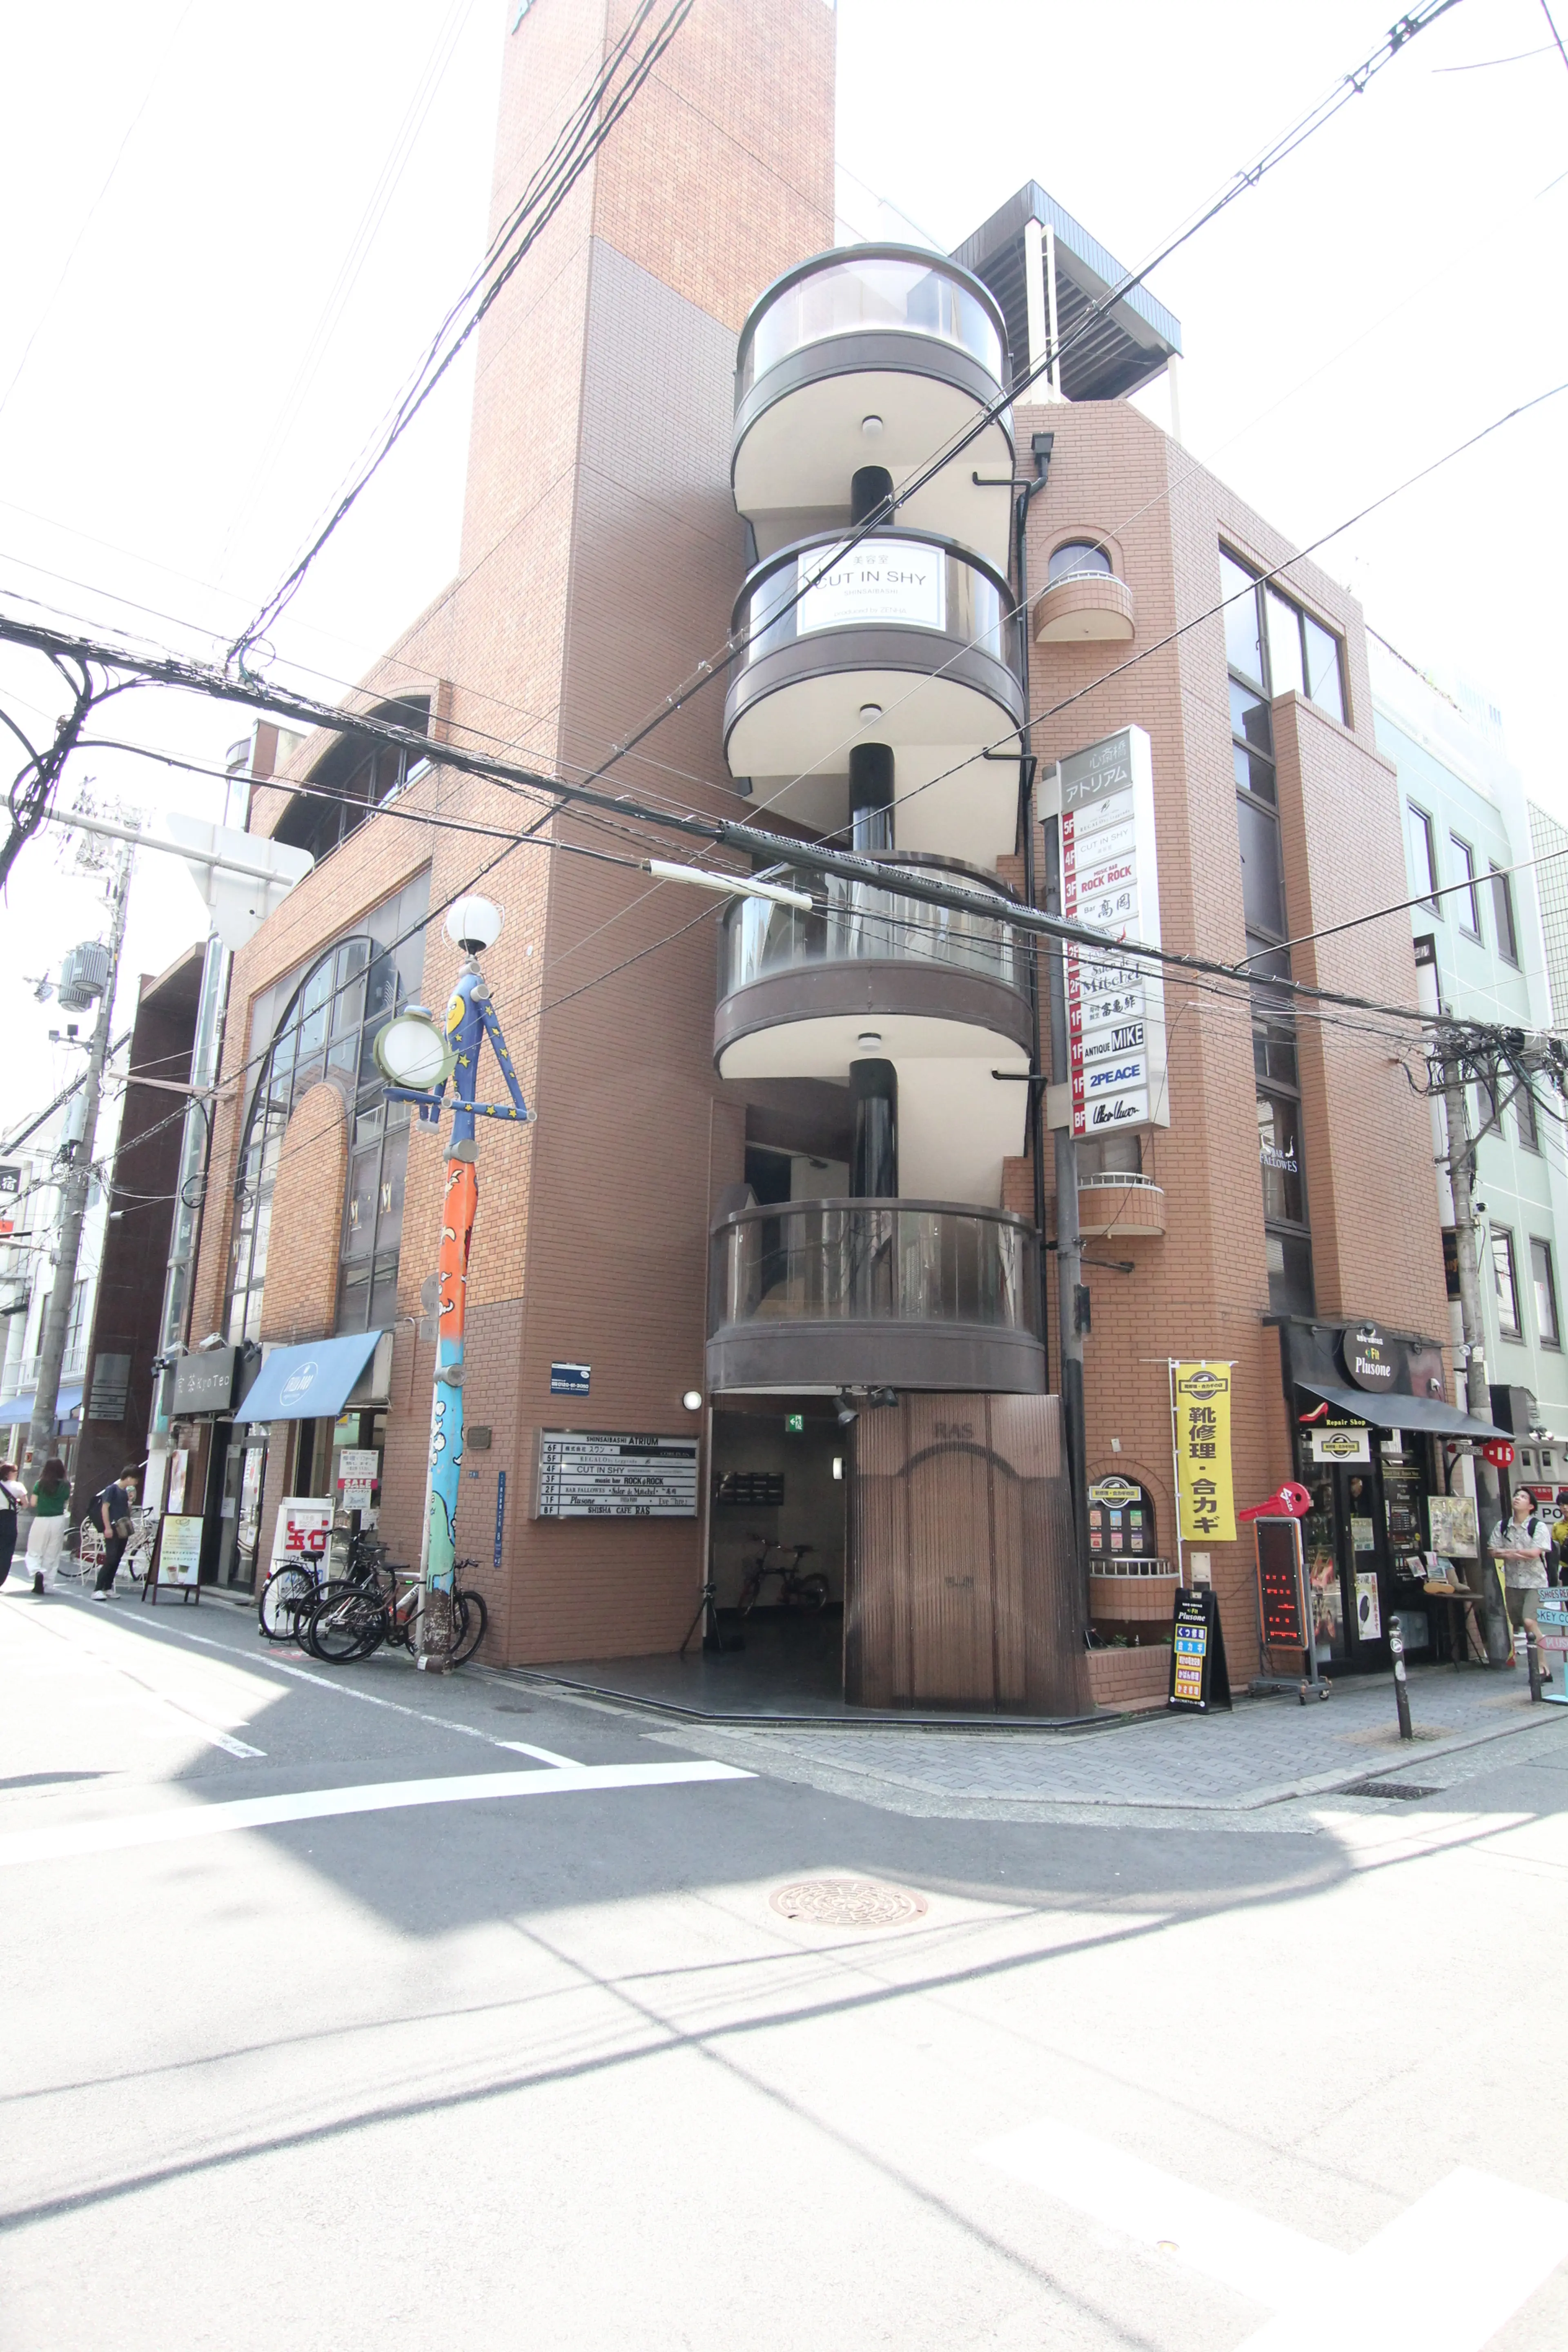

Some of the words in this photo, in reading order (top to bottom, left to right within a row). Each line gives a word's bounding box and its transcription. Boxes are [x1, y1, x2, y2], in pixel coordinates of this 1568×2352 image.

[853, 555, 889, 565] 美容室
[816, 572, 854, 589] CUT
[861, 571, 879, 582] IN
[886, 571, 926, 585] SHY
[1089, 740, 1127, 768] 心斎橋
[1066, 766, 1127, 803] アトリアム
[1064, 819, 1074, 835] 5F
[1080, 840, 1098, 853] CUT
[1100, 837, 1109, 845] IN
[1111, 829, 1129, 841] SHY
[1065, 850, 1075, 865] 4F
[1081, 875, 1105, 893] ROCK
[1107, 865, 1132, 883] ROCK
[1094, 867, 1108, 877] MUSIC
[1066, 882, 1077, 897] 3F
[1084, 905, 1096, 914] Bar
[1069, 977, 1080, 994] 2F
[1071, 1009, 1081, 1027] 1F
[1085, 1042, 1111, 1058] ANTIQUE
[1111, 1024, 1143, 1051] MIKE
[1072, 1042, 1082, 1060] 1F
[1090, 1064, 1140, 1087] 2PEACE
[1073, 1076, 1084, 1094] 1F
[1074, 1110, 1086, 1128] BF
[1271, 1148, 1284, 1159] BAR
[1259, 1152, 1298, 1173] FALLOWES
[1, 1175, 18, 1192] 宿
[1355, 1356, 1391, 1377] Plusone
[629, 1437, 659, 1446] ATRIUM
[1188, 1407, 1218, 1534] 靴修理・合カギ
[344, 1479, 372, 1489] SALE
[635, 1507, 650, 1515] RAS
[1540, 1589, 1559, 1599] SHOES
[1178, 1612, 1206, 1622] Plusone
[1540, 1610, 1557, 1622] KEY
[1546, 1637, 1568, 1648] PLUS
